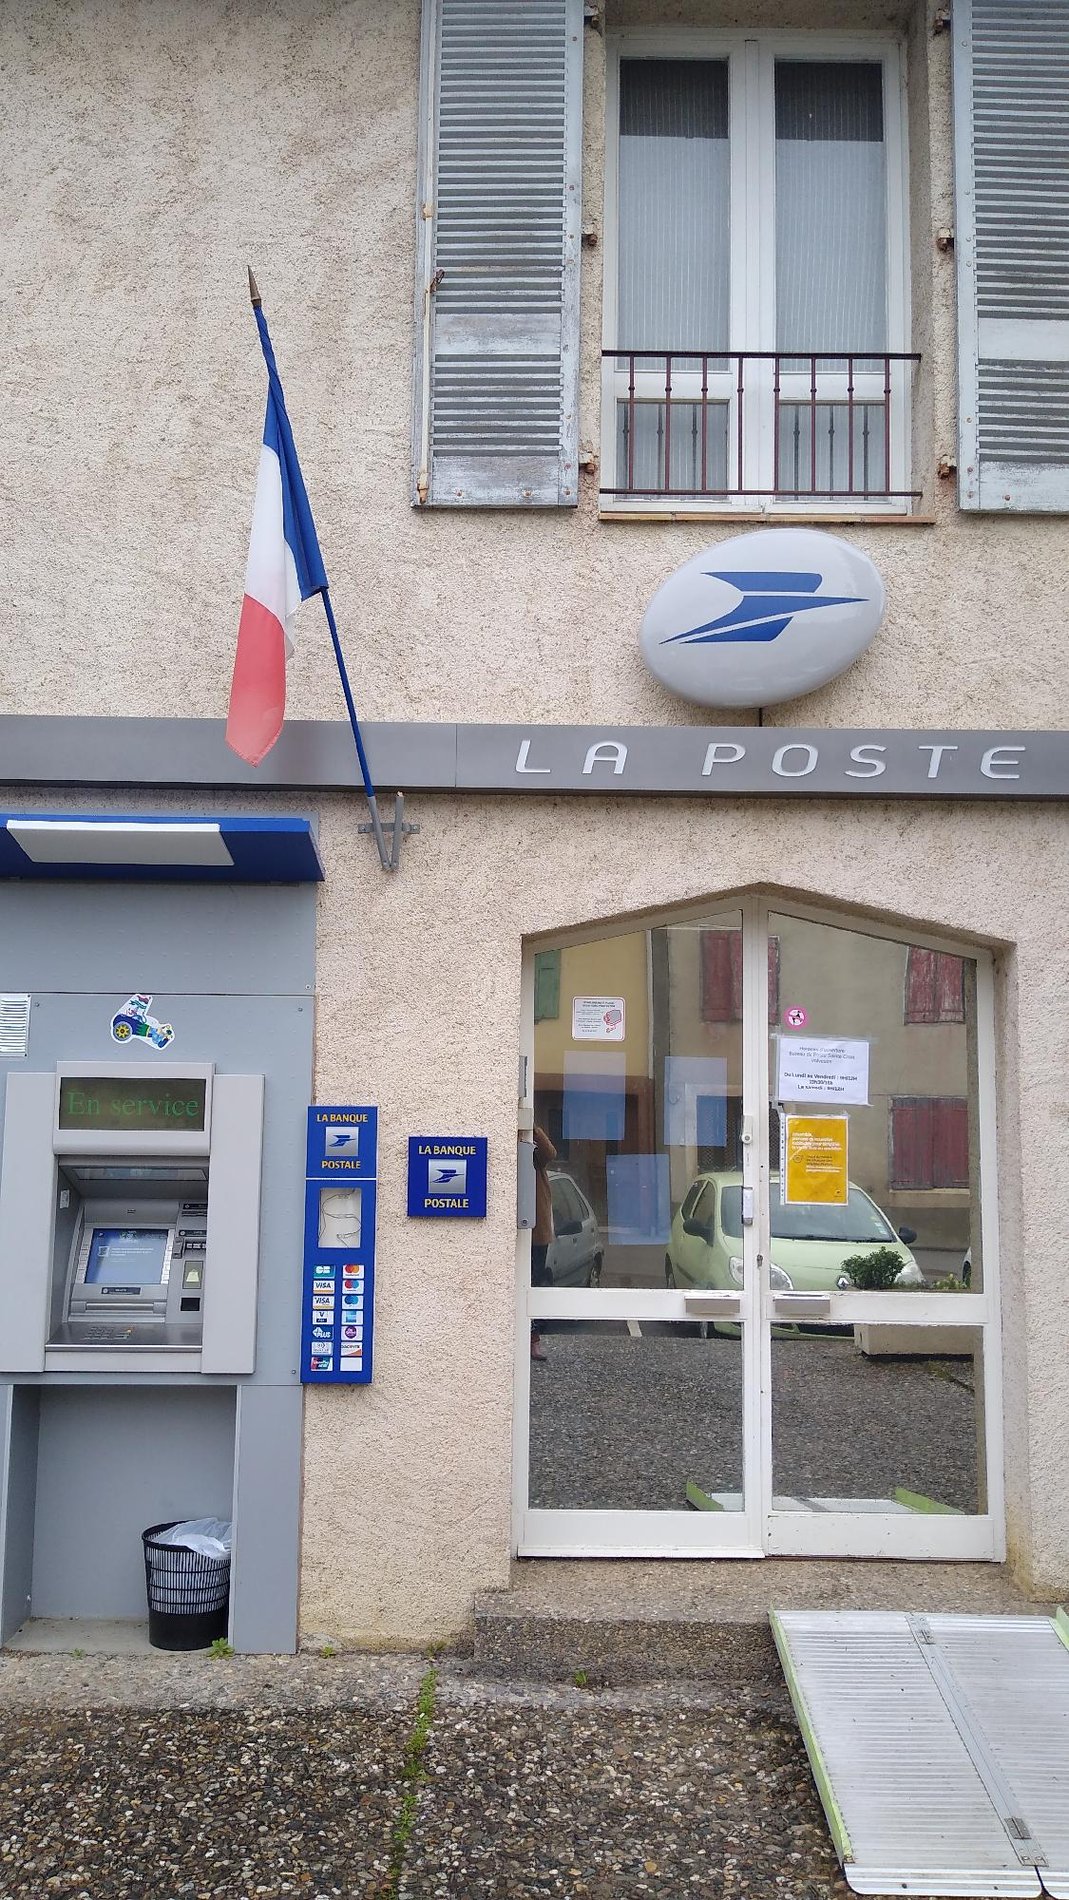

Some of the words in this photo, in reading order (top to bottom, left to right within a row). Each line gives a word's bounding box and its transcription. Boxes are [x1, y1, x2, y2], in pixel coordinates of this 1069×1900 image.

[514, 739, 630, 775] LA
[701, 742, 1027, 779] POSTE
[66, 1091, 100, 1116] En
[110, 1093, 199, 1116] service
[317, 1113, 328, 1122] LA
[330, 1114, 368, 1123] BANQUE
[418, 1145, 431, 1155] LA
[433, 1145, 476, 1156] BANQUE
[321, 1160, 361, 1169] POSTALE
[424, 1198, 469, 1208] POSTALE
